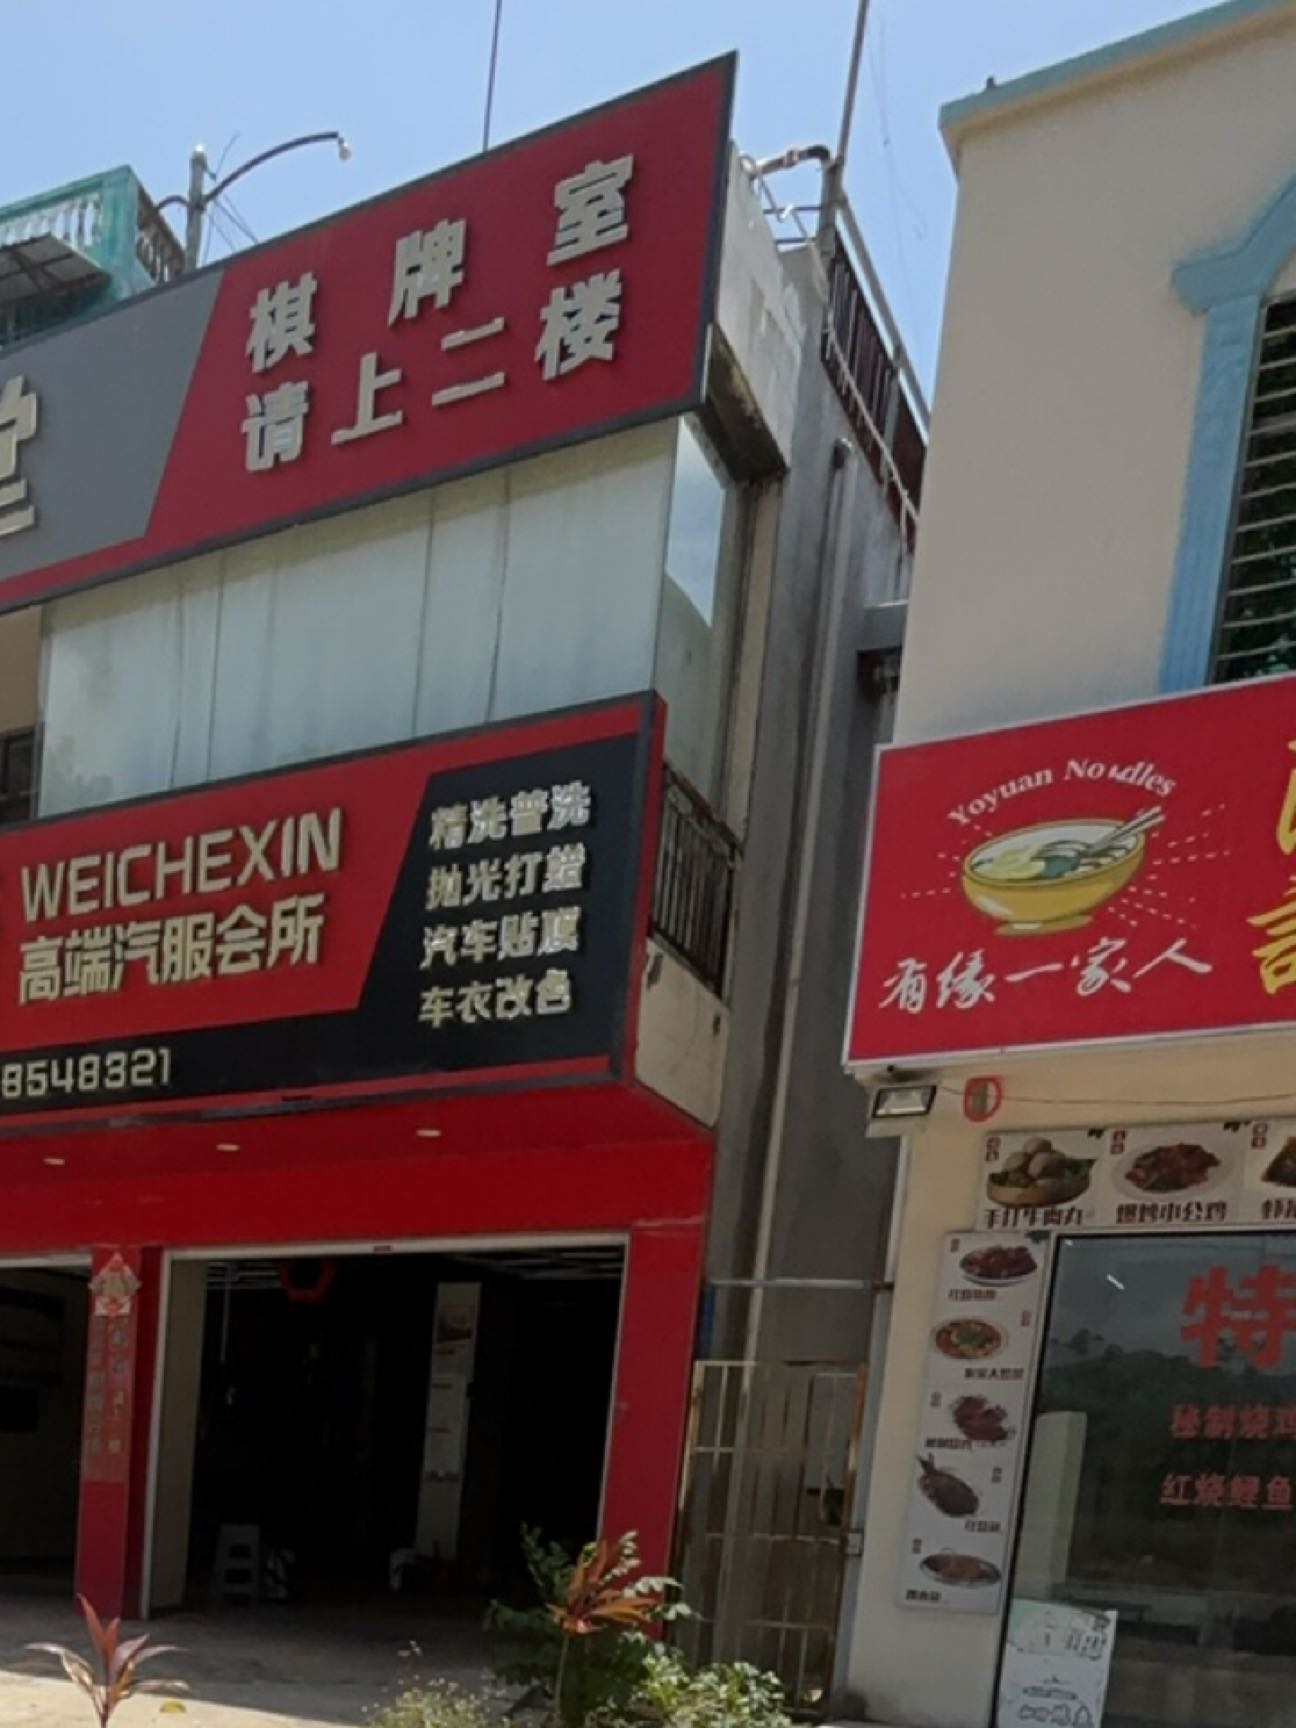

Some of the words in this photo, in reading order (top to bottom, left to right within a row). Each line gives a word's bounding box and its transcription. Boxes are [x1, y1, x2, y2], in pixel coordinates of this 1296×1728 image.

[245, 154, 634, 374] 棋牌室
[241, 269, 623, 472] 请上二楼
[429, 780, 592, 851] 精洗普洗
[947, 767, 1054, 828] Yoyuan
[21, 808, 341, 922] WEICHEXIN
[424, 841, 586, 912] 抛光打蜡
[18, 892, 325, 1005] 高端汽服会所
[418, 905, 582, 970] 汽车贴膜
[417, 967, 571, 1028] 车衣改色
[878, 936, 1212, 1014] 有缘一家人
